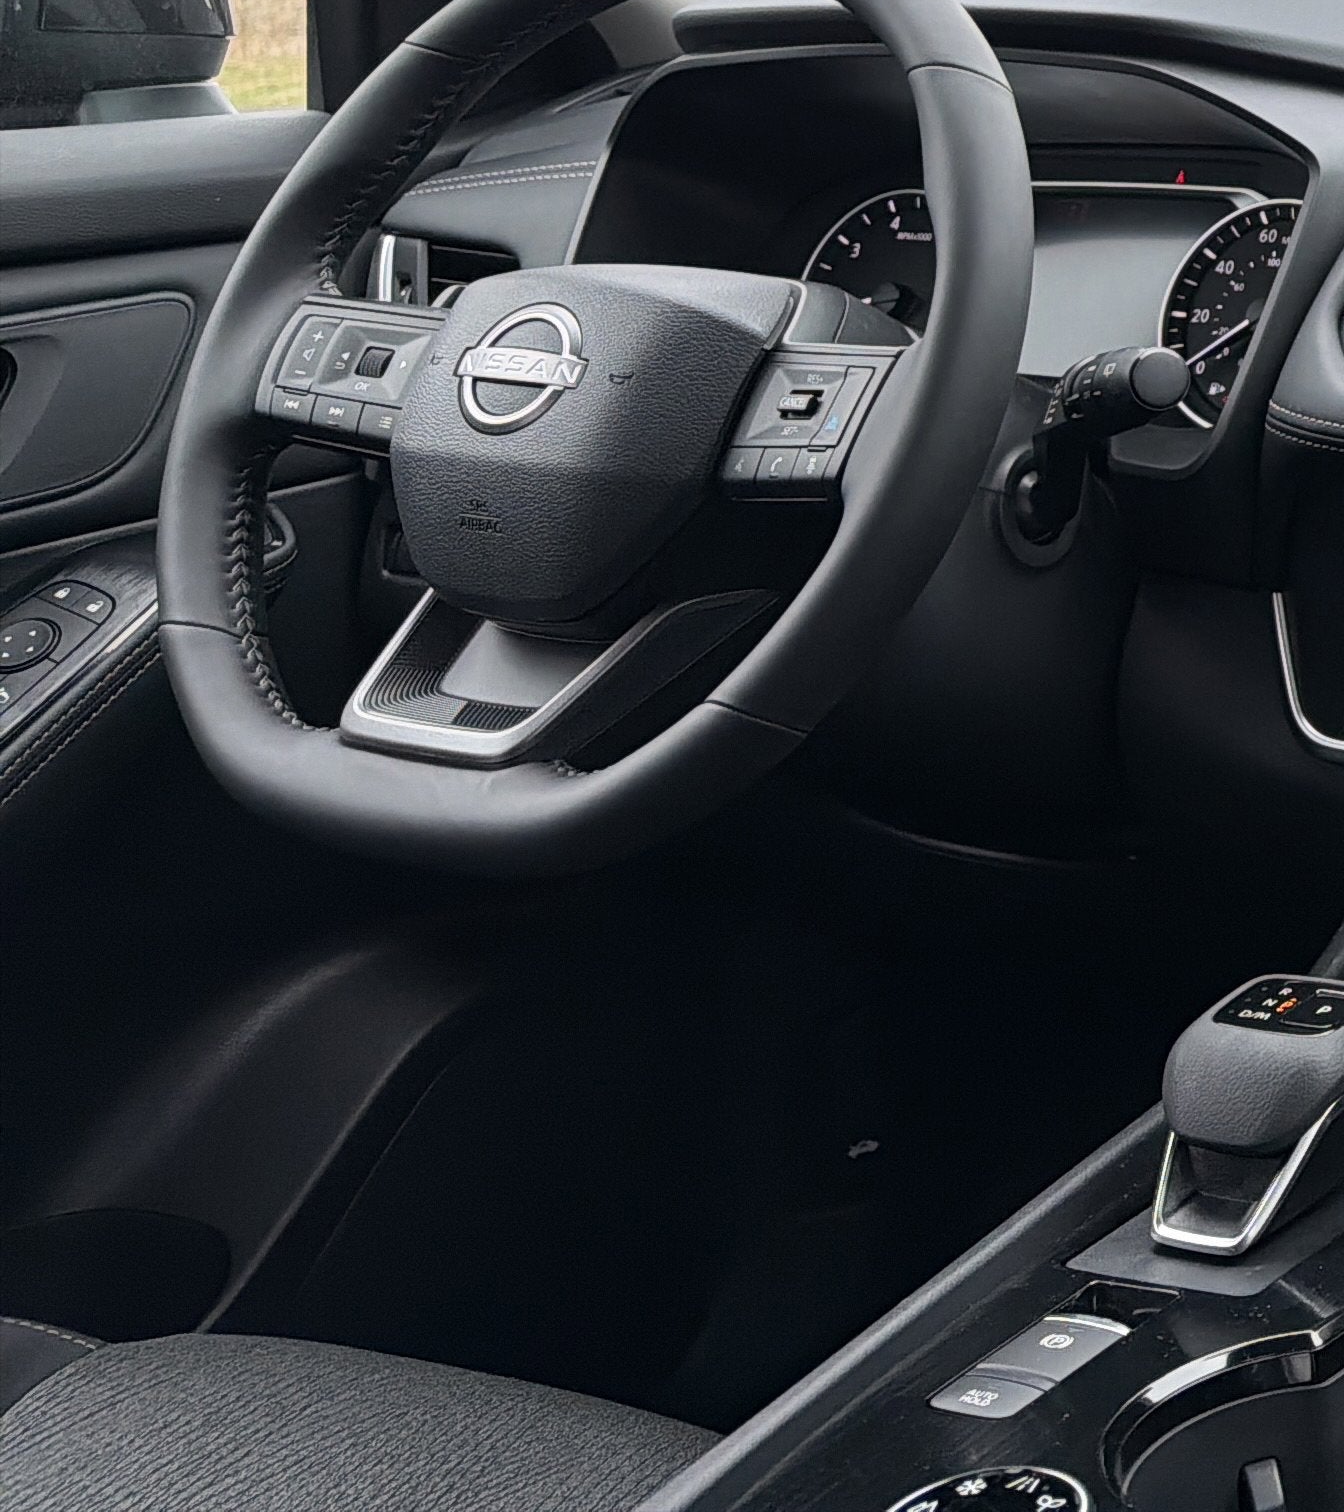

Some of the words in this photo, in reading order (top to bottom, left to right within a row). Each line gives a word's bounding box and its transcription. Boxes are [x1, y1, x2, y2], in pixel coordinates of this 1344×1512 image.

[890, 215, 901, 231] 4
[1259, 229, 1278, 243] 60
[849, 242, 861, 258] 3
[1215, 260, 1235, 275] 40
[1267, 258, 1281, 268] 100
[1191, 308, 1210, 323] 20
[460, 351, 583, 385] NISSAN
[1195, 360, 1205, 375] 0
[1237, 1009, 1271, 1021] D/M
[958, 1395, 991, 1407] HOLD
[965, 1389, 999, 1401] AUTO
